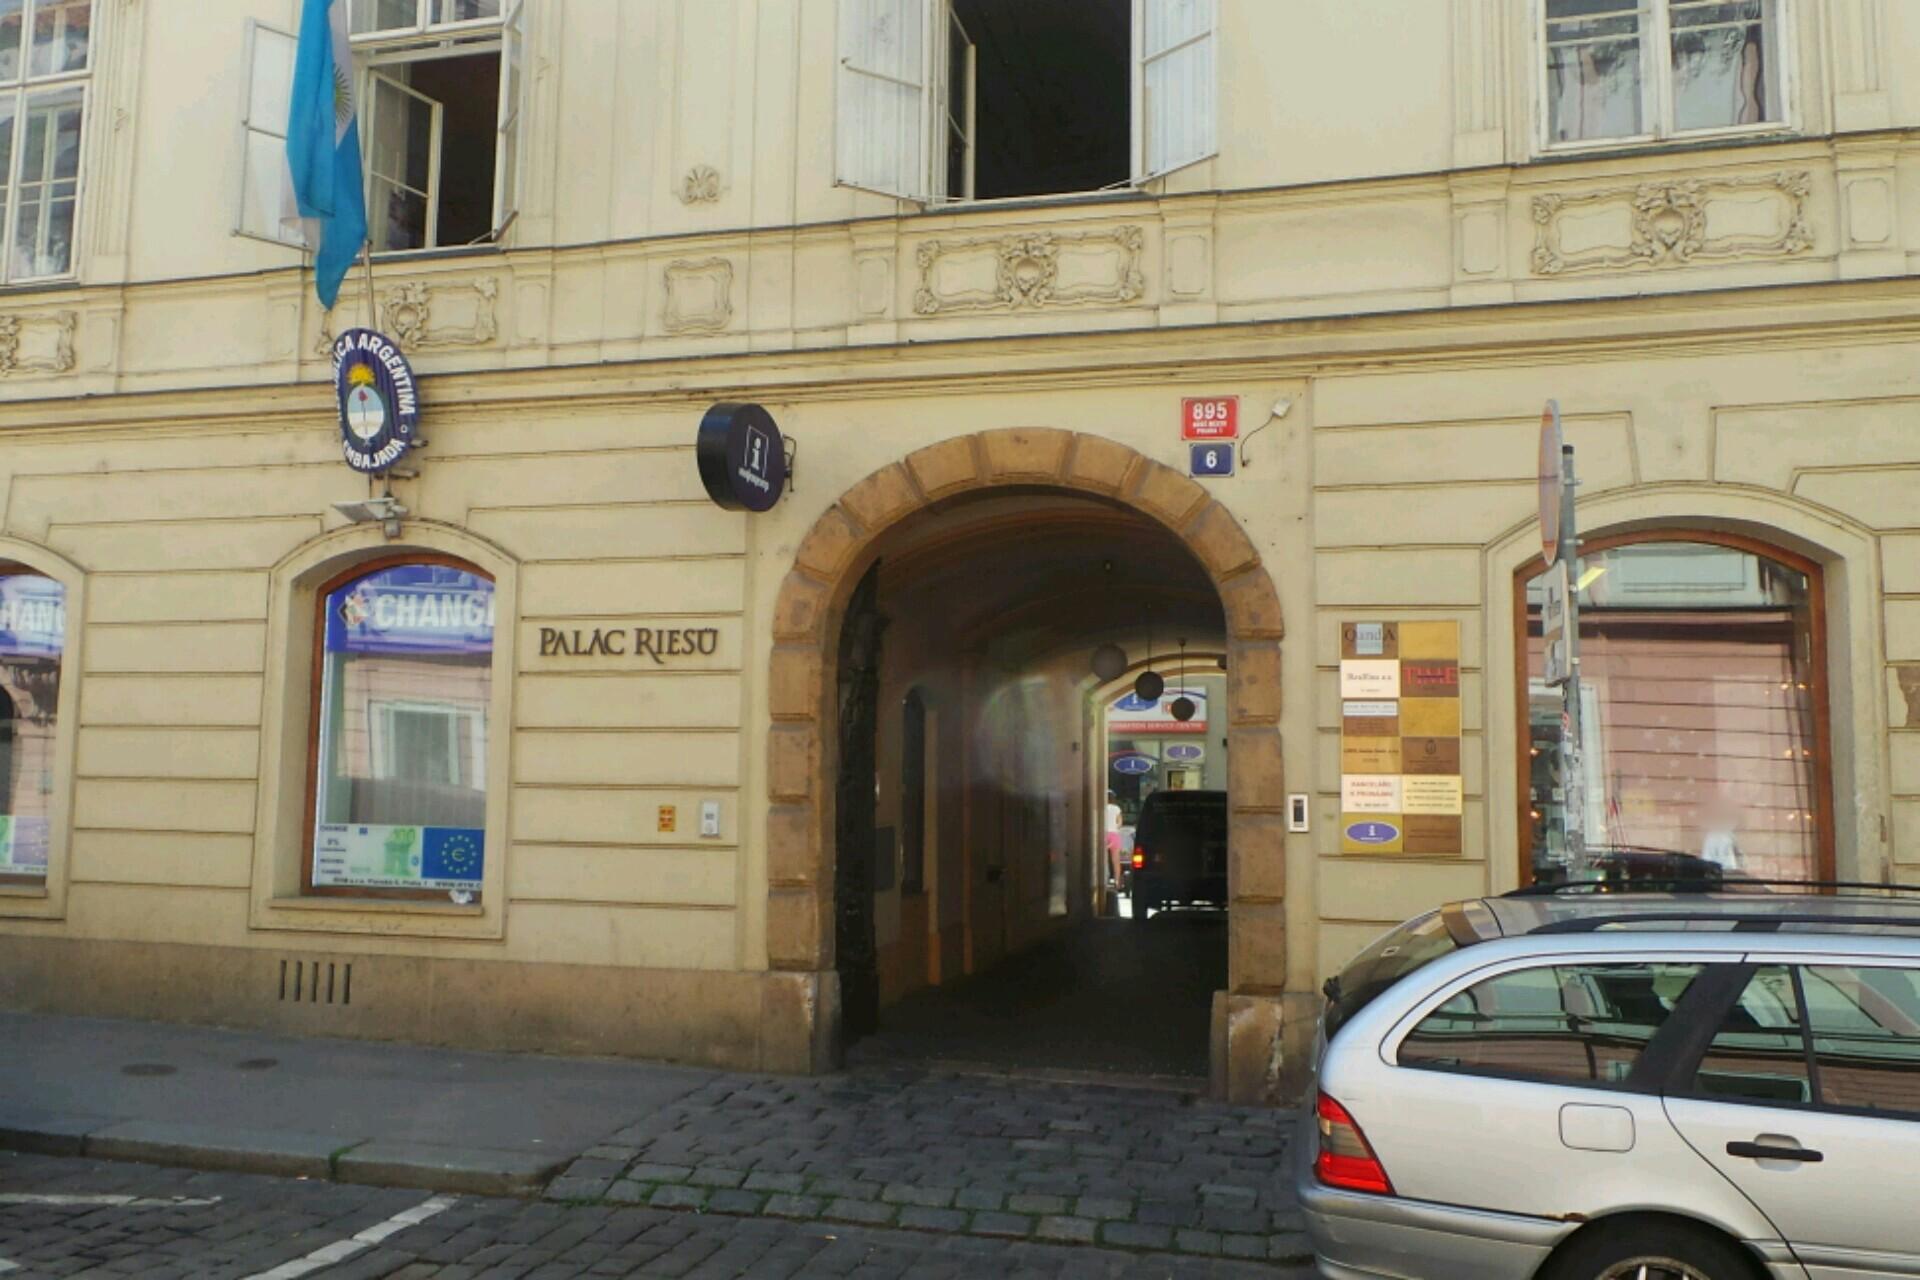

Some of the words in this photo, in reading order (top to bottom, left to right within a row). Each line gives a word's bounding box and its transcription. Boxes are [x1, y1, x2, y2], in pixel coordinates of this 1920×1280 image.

[357, 333, 416, 415] ARGENTINA
[1192, 401, 1228, 420] 895
[344, 437, 406, 469] EMBAJADA
[1206, 450, 1217, 469] 6
